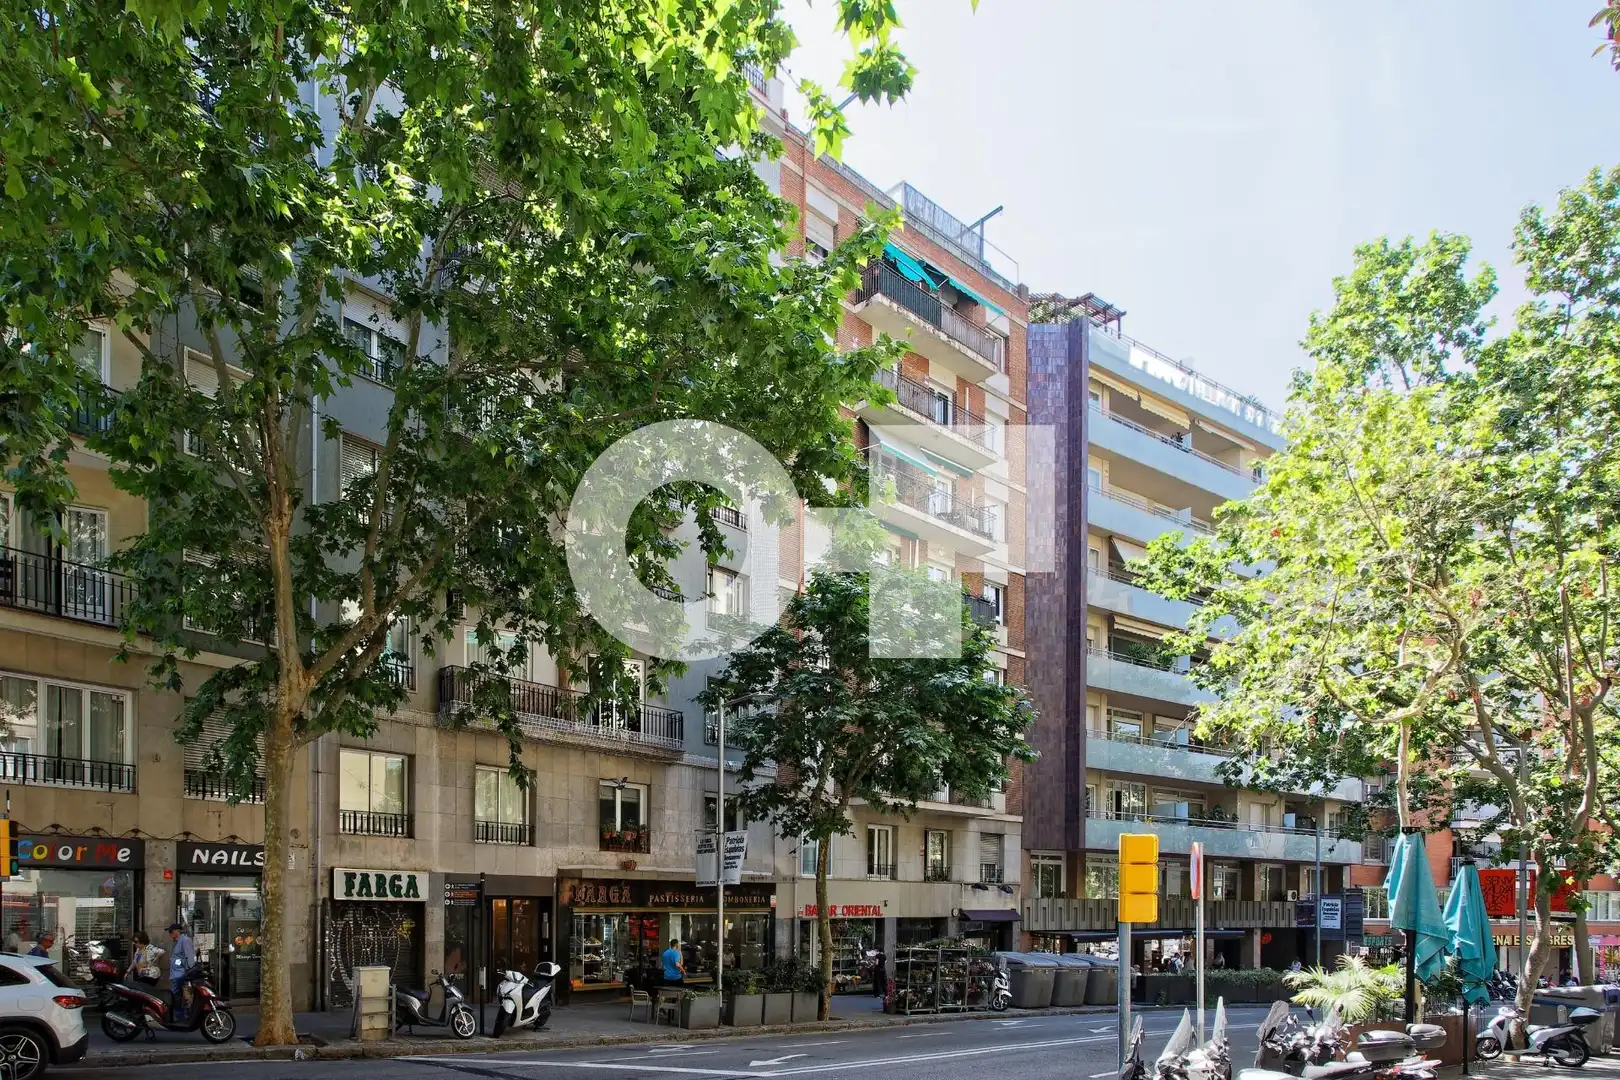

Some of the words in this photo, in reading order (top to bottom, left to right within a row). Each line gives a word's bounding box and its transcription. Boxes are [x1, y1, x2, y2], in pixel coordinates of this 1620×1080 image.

[18, 840, 88, 861] Color
[95, 843, 131, 863] Me
[192, 849, 265, 866] NAILS
[344, 872, 420, 898] FARGA
[649, 894, 705, 904] PASTISSERIA
[721, 895, 766, 904] OMBONERIA
[805, 904, 837, 916] BAR
[842, 904, 883, 917] ORIENTAL
